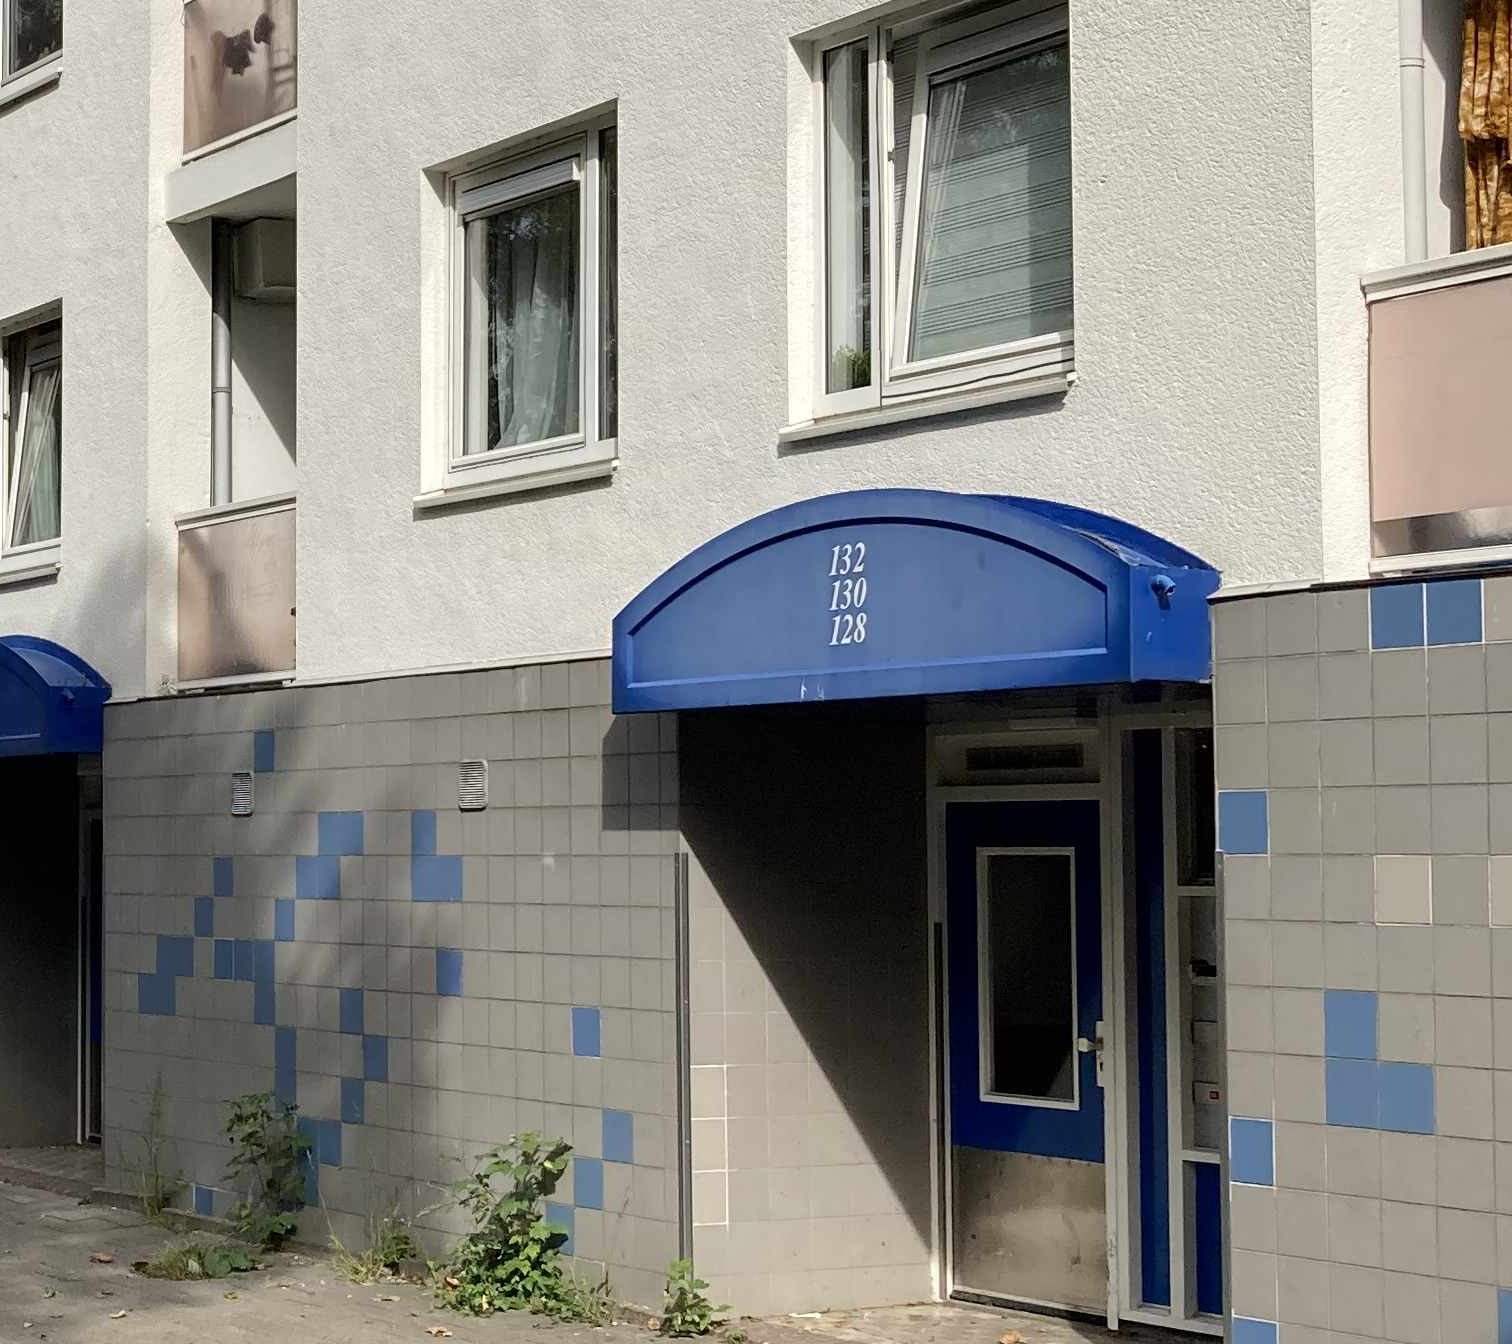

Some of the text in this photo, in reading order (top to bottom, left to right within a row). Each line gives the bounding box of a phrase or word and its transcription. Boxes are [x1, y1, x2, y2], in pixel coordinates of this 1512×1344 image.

[828, 541, 867, 576] 132
[828, 577, 868, 610] 130
[828, 611, 868, 645] 128
